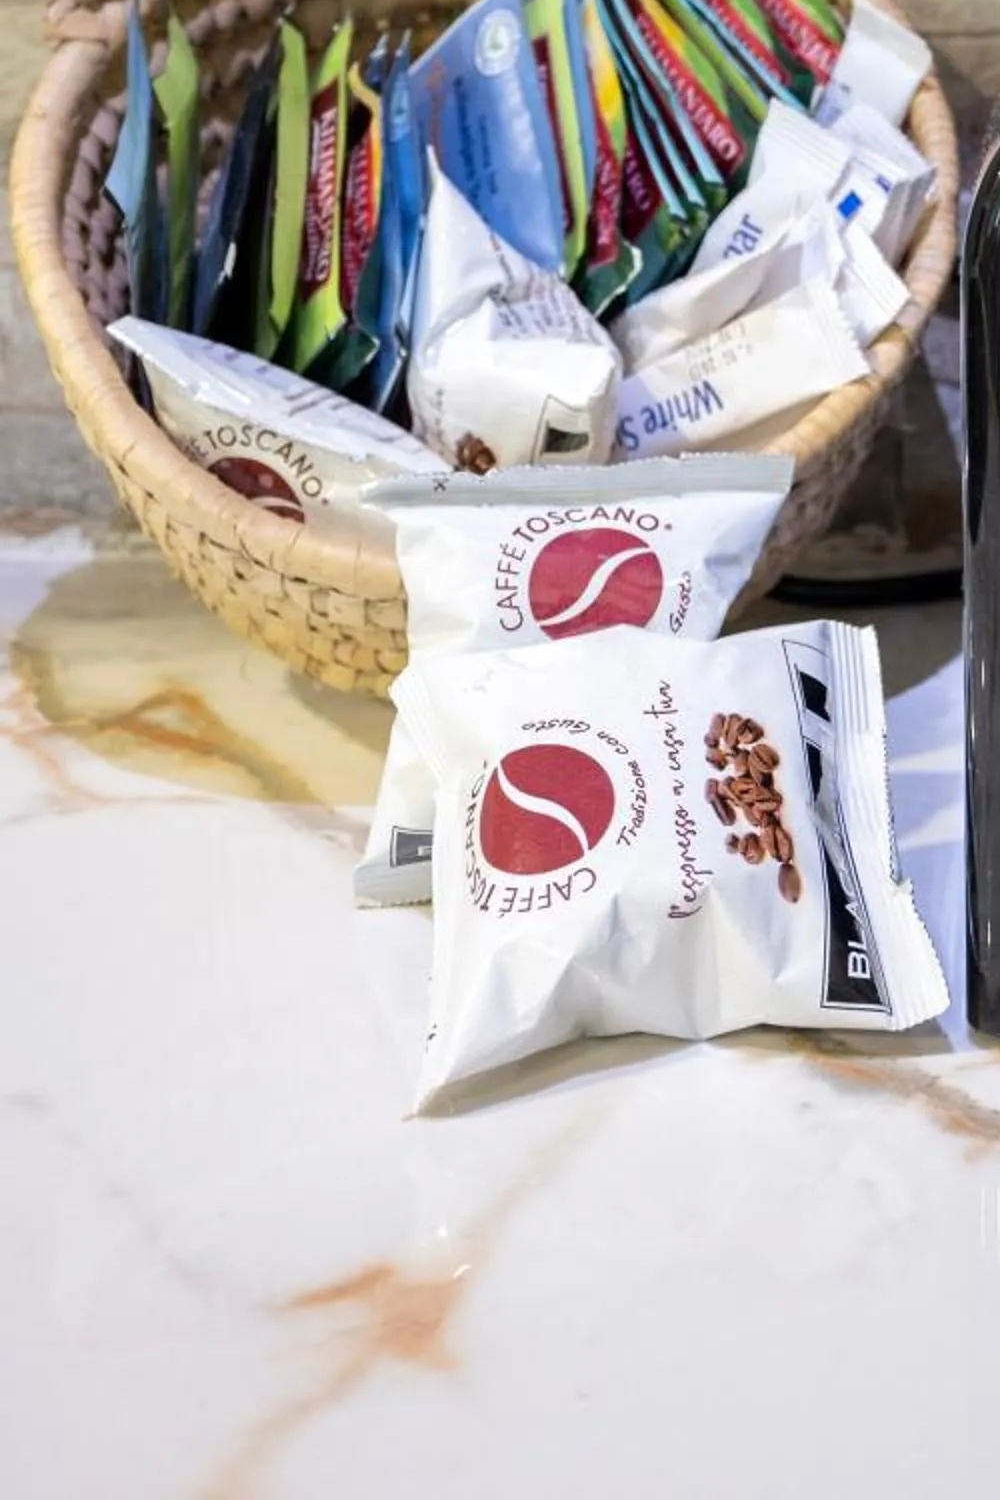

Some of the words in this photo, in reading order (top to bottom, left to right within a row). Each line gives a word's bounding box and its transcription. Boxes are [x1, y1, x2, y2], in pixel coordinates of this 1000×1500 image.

[616, 415, 641, 451] S
[641, 379, 724, 432] White
[203, 425, 323, 498] TOSCANO
[495, 542, 526, 632] CAFFÉ
[512, 506, 660, 543] TOSCANO
[616, 760, 648, 847] Tradizione
